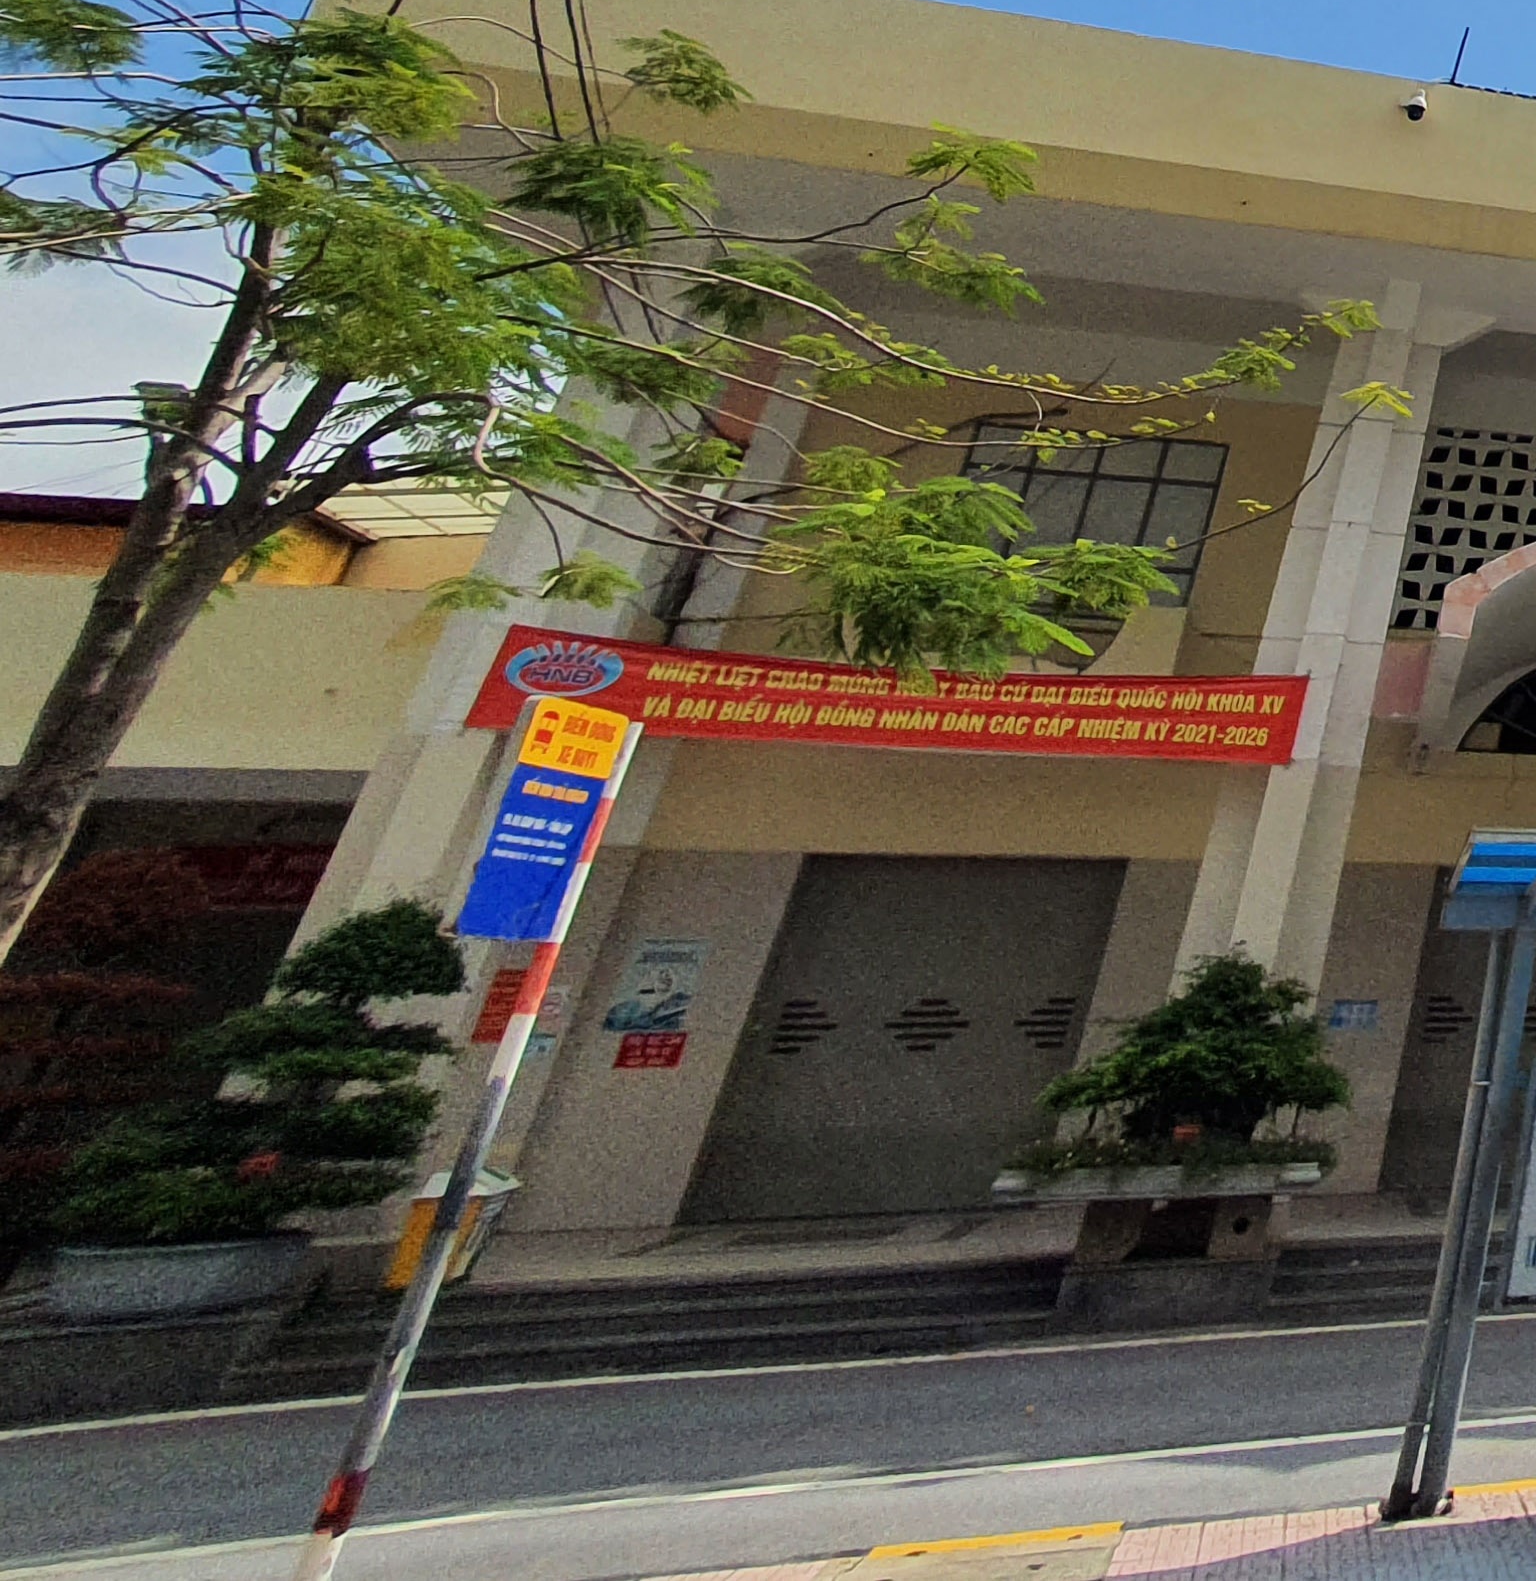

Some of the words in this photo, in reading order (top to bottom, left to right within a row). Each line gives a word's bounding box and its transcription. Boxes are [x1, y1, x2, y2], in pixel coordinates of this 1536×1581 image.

[526, 666, 596, 685] HNB
[646, 660, 714, 688] NHIỆT
[894, 681, 951, 699] NY
[1259, 695, 1286, 715] XV
[643, 693, 672, 718] VÀ
[878, 706, 940, 731] NHÂN
[941, 708, 986, 733] DÂN
[1033, 710, 1075, 737] CẤP
[1077, 716, 1143, 744] NHIỆM
[1144, 718, 1171, 742] KỲ
[1172, 723, 1270, 747] 2021-2026
